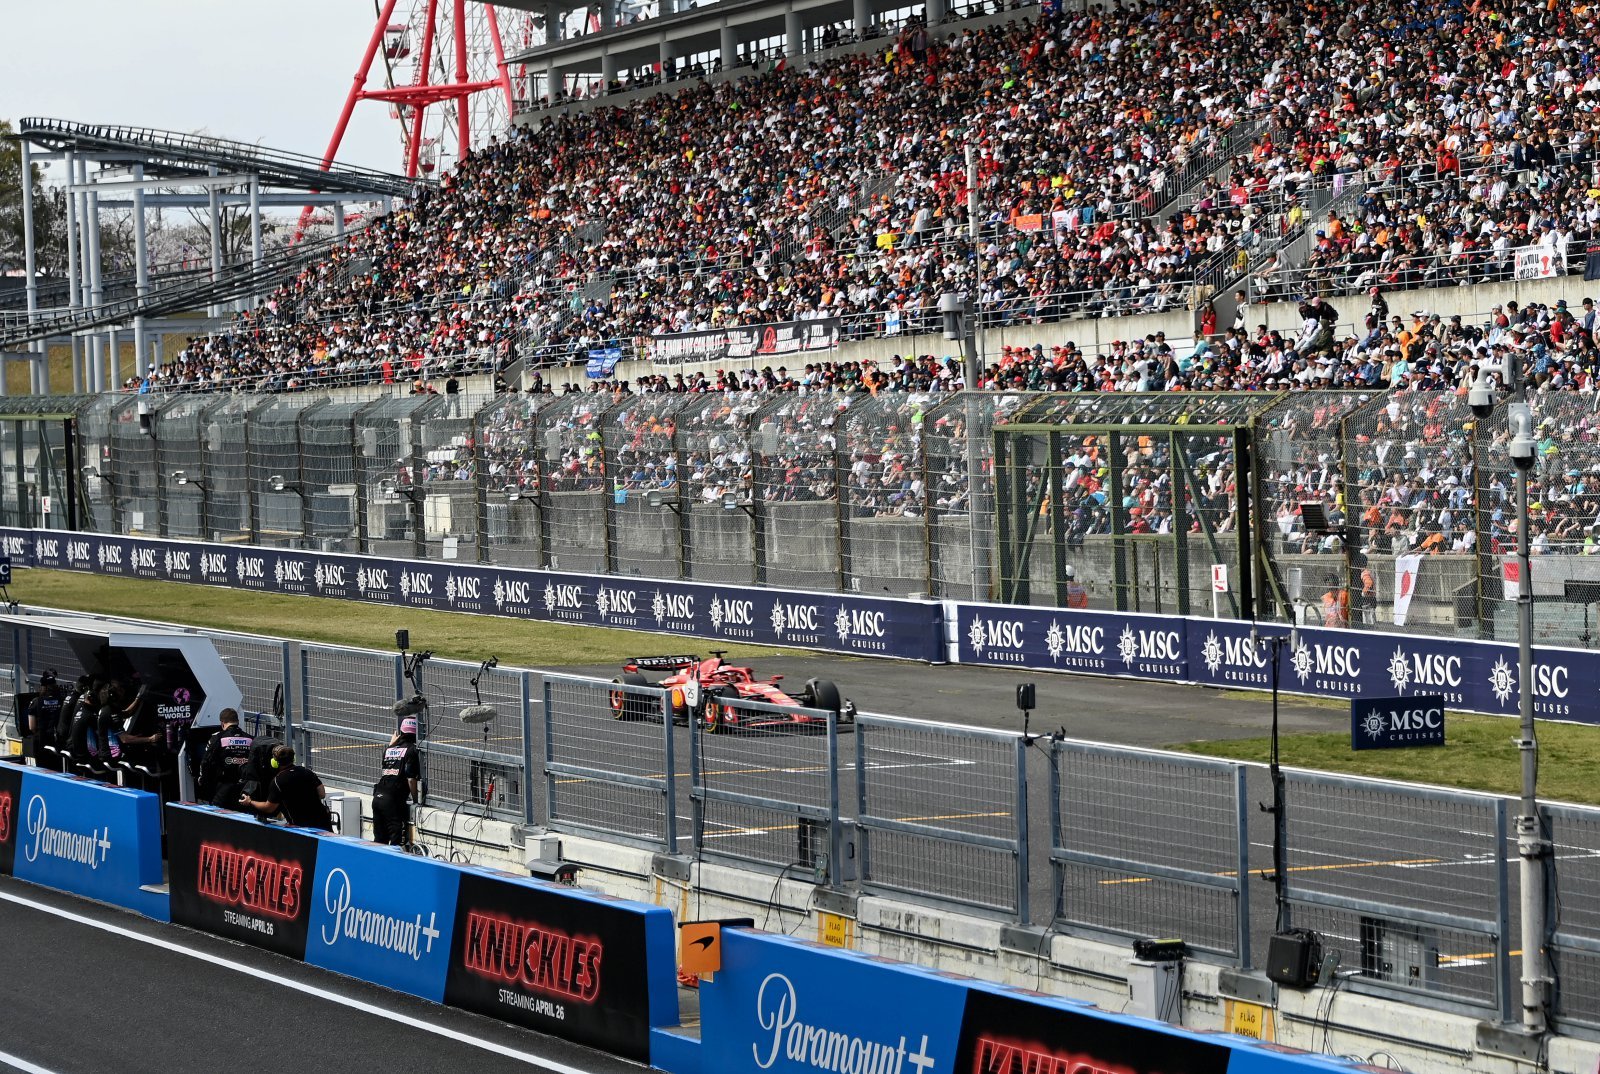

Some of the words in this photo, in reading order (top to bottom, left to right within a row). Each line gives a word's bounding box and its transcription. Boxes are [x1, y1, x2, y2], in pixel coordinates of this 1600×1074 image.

[9, 537, 25, 554] MSC
[43, 539, 59, 557] MSC
[74, 542, 90, 560] MSC
[106, 545, 122, 563] MSC
[139, 548, 156, 567] MSC
[173, 551, 191, 570] MSC
[209, 554, 227, 573] MSC
[246, 557, 264, 577] MSC
[284, 561, 303, 581] MSC
[325, 564, 345, 585] MSC
[367, 568, 388, 589] MSC
[411, 572, 433, 594] MSC
[457, 576, 480, 599] MSC
[505, 581, 530, 603] MSC
[457, 601, 481, 610] CRUISES
[557, 585, 582, 608] MSC
[609, 588, 636, 614] MSC
[666, 593, 694, 619] MSC
[505, 606, 531, 615] CRUISES
[557, 611, 583, 620] CRUISES
[724, 599, 753, 625] MSC
[787, 604, 818, 631] MSC
[610, 616, 637, 626] CRUISES
[667, 621, 695, 632] CRUISES
[852, 610, 884, 637] MSC
[724, 627, 754, 638] CRUISES
[787, 633, 818, 644] CRUISES
[987, 620, 1024, 648] MSC
[1065, 625, 1104, 654] MSC
[851, 639, 886, 651] CRUISES
[1139, 630, 1180, 660] MSC
[1224, 637, 1267, 668] MSC
[987, 652, 1025, 662] CRUISES
[1066, 658, 1105, 668] CRUISES
[1314, 644, 1361, 677] MSC
[1140, 664, 1181, 675] CRUISES
[1225, 671, 1267, 683] CRUISES
[1412, 653, 1462, 687] MSC
[688, 688, 697, 700] 25
[1316, 680, 1362, 693] CRUISES
[157, 705, 191, 714] CHANGE
[1390, 709, 1441, 730] MSC
[1390, 732, 1442, 740] CRUISES
[25, 795, 111, 870] Paramount+
[199, 844, 303, 918] KNUCKLES
[224, 910, 251, 929] STREAMING
[251, 918, 267, 933] APRIL
[267, 922, 274, 936] 26
[321, 868, 440, 961] Paramount+
[829, 922, 841, 931] FLAG
[465, 912, 602, 1001] KNUCKLES
[498, 988, 535, 1012] STREAMING
[535, 1000, 556, 1019] APRIL
[555, 1004, 565, 1020] 26
[752, 972, 935, 1074] Paramount+
[1240, 1012, 1256, 1024] FLAG
